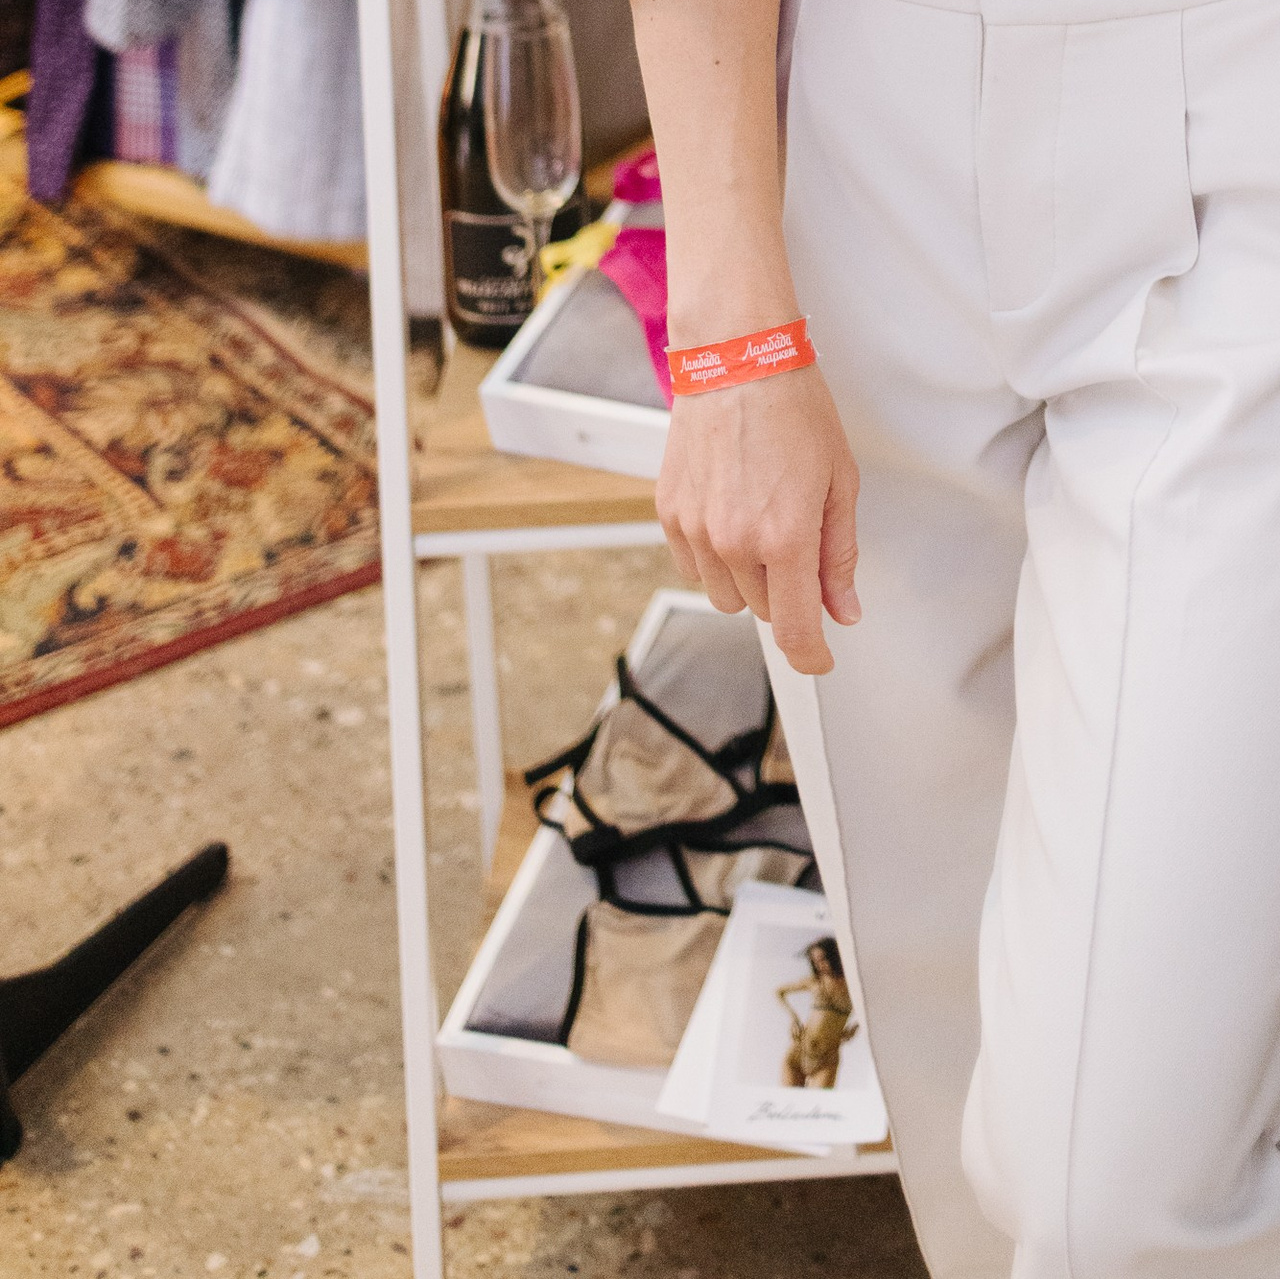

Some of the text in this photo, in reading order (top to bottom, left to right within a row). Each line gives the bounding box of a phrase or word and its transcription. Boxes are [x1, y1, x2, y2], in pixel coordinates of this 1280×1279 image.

[741, 332, 793, 361] Ламбада
[756, 346, 799, 367] маркет
[680, 350, 722, 373] Ламбада
[690, 366, 728, 384] маркет
